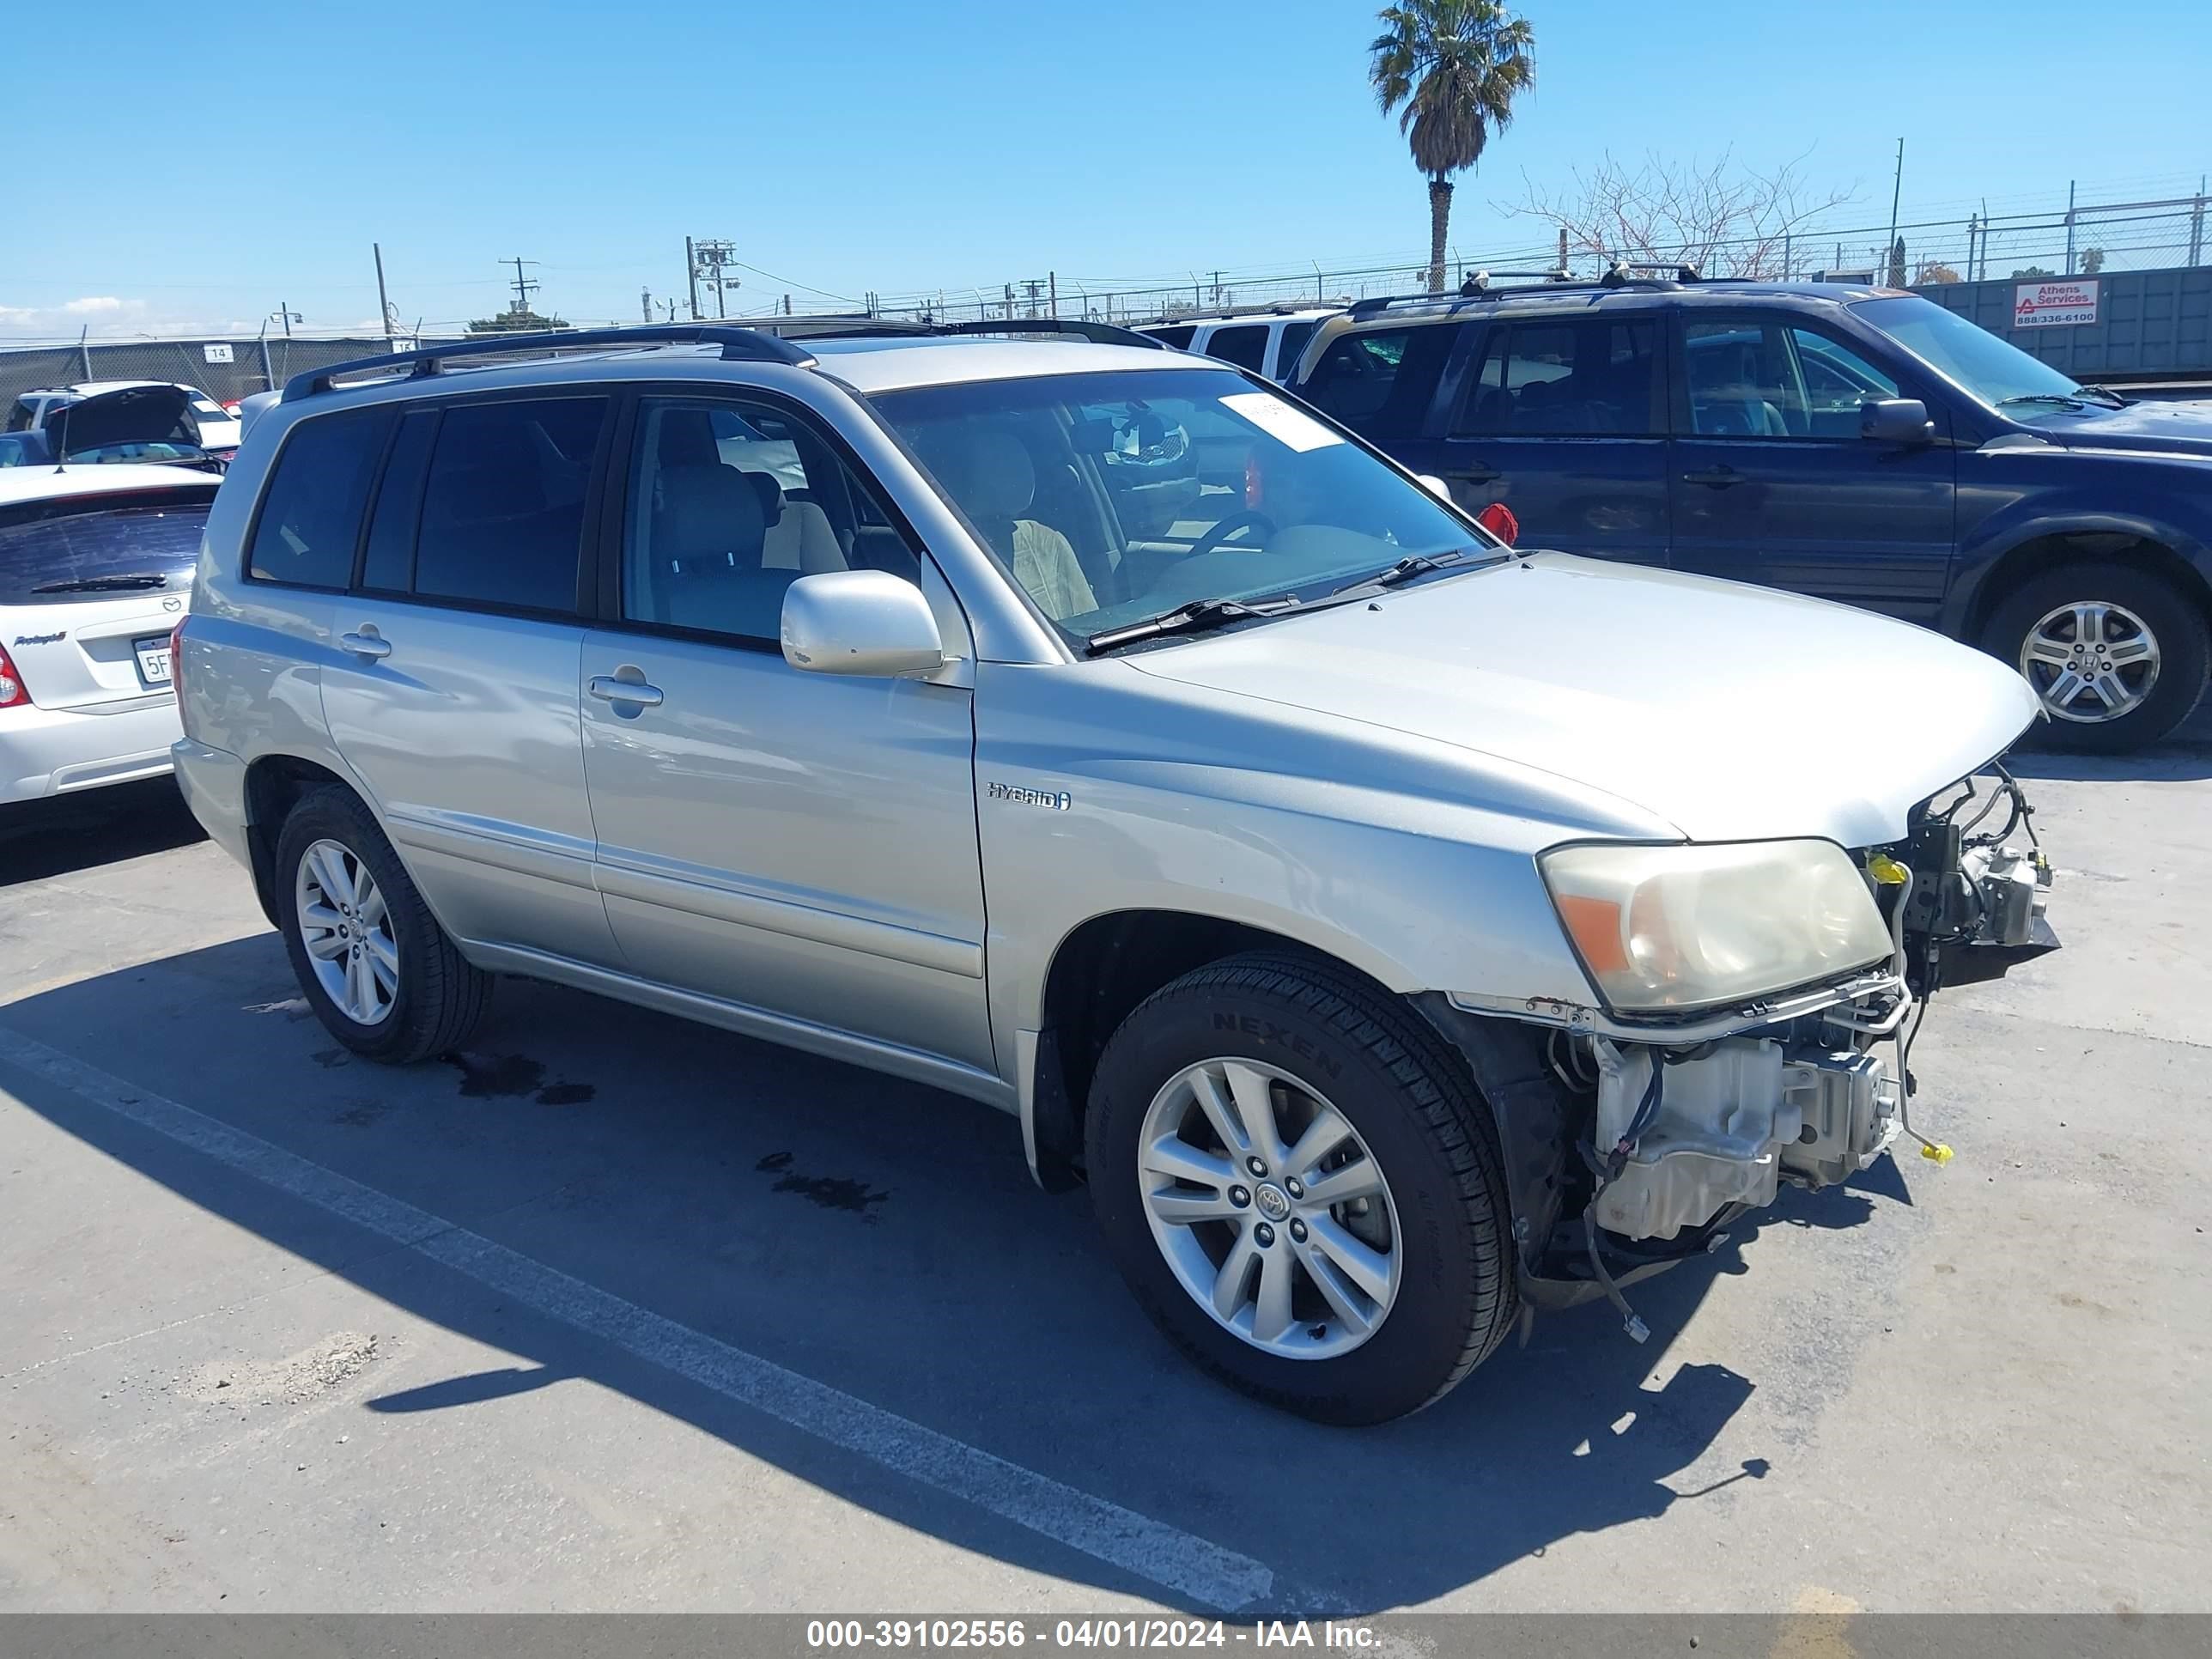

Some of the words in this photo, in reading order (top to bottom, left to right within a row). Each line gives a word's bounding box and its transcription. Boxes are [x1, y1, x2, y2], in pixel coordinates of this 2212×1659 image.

[2039, 286, 2081, 295] Athens
[2037, 295, 2089, 304] Services
[2017, 313, 2094, 325] 888/336-6100
[212, 348, 226, 358] 14
[987, 781, 1059, 809] HYBRID
[1212, 1012, 1343, 1080] NEXEN
